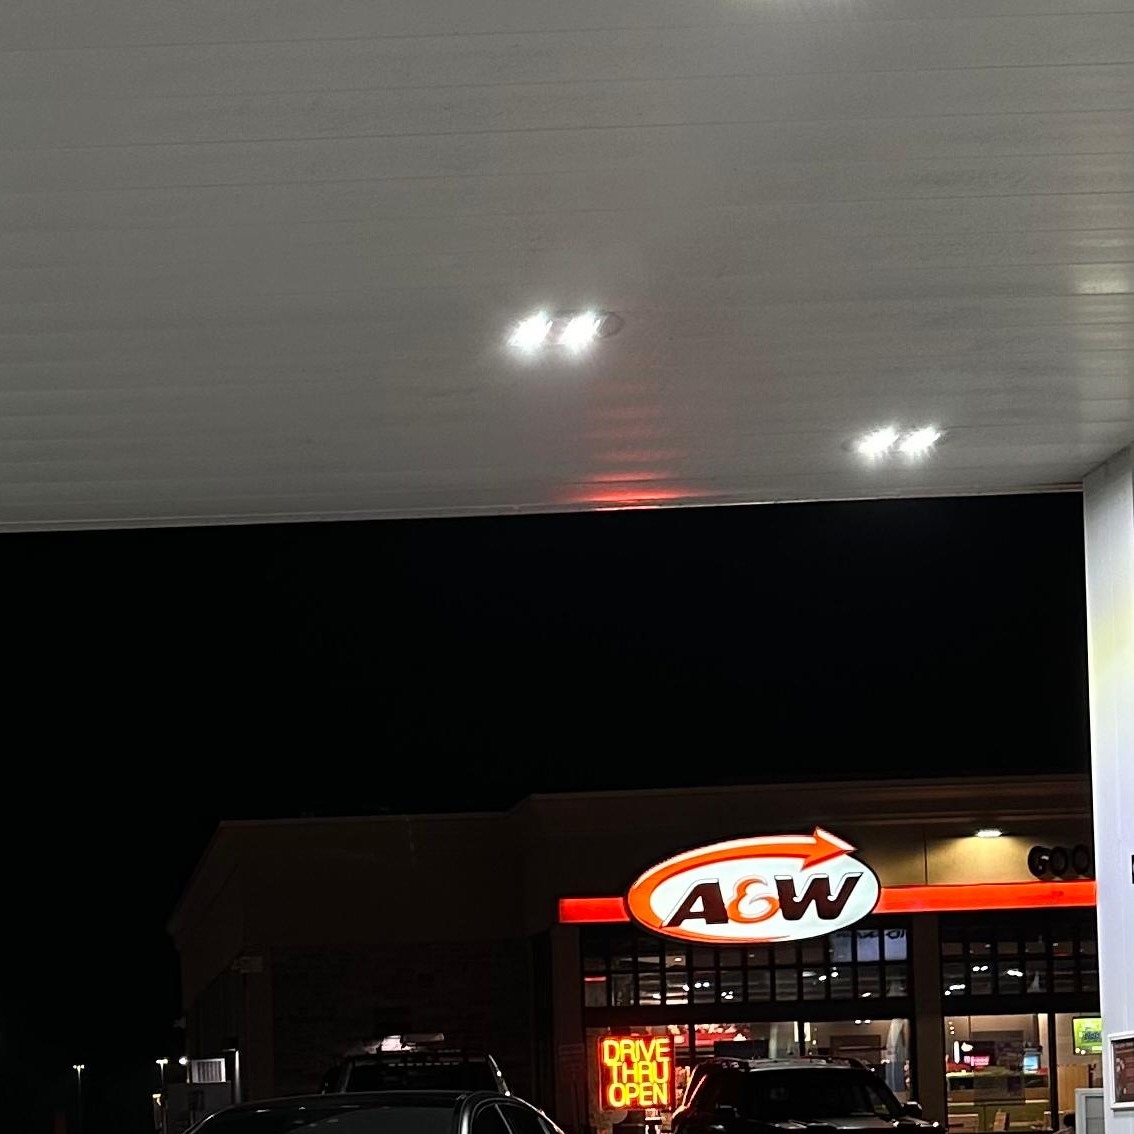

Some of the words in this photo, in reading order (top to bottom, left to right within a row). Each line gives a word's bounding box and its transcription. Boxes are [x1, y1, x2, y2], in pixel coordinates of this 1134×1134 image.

[661, 872, 864, 928] A&W
[603, 1038, 670, 1063] DRIVE
[607, 1061, 670, 1083] THRU
[608, 1081, 668, 1107] OPEN
